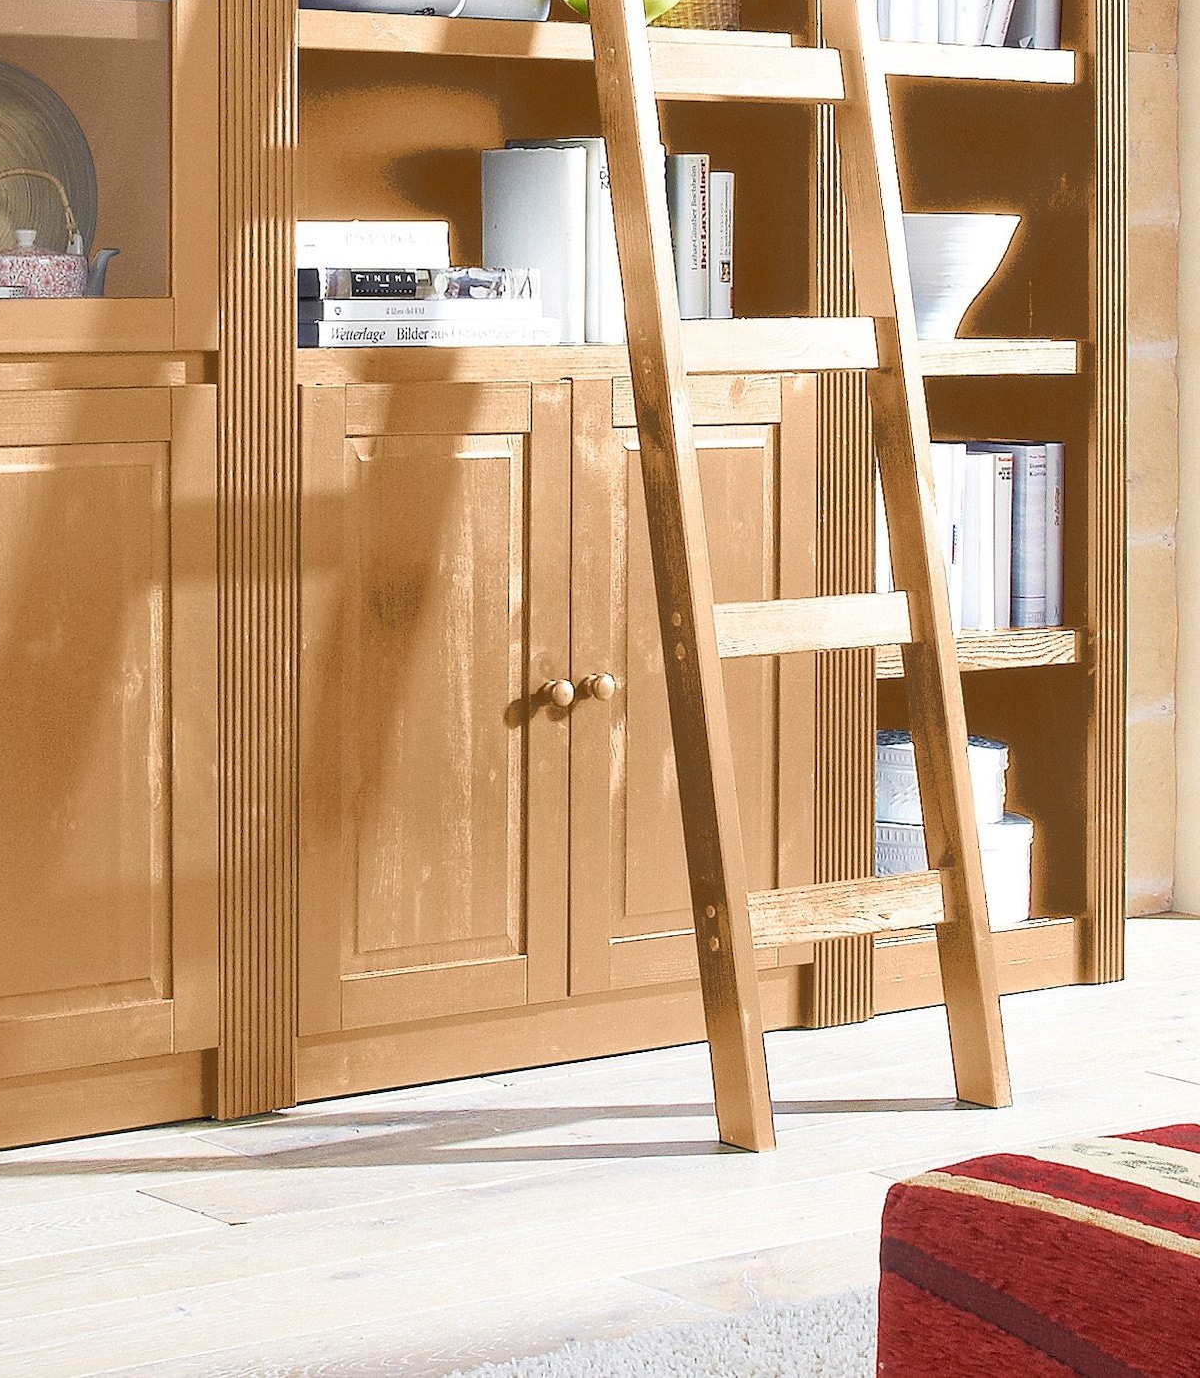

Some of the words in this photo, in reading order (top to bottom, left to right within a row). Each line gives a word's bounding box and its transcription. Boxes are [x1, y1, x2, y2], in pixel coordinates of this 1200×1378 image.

[699, 159, 707, 240] Luxusliner
[355, 274, 413, 283] CINEMA
[330, 326, 386, 343] Wetterlage
[396, 326, 429, 340] Bilder
